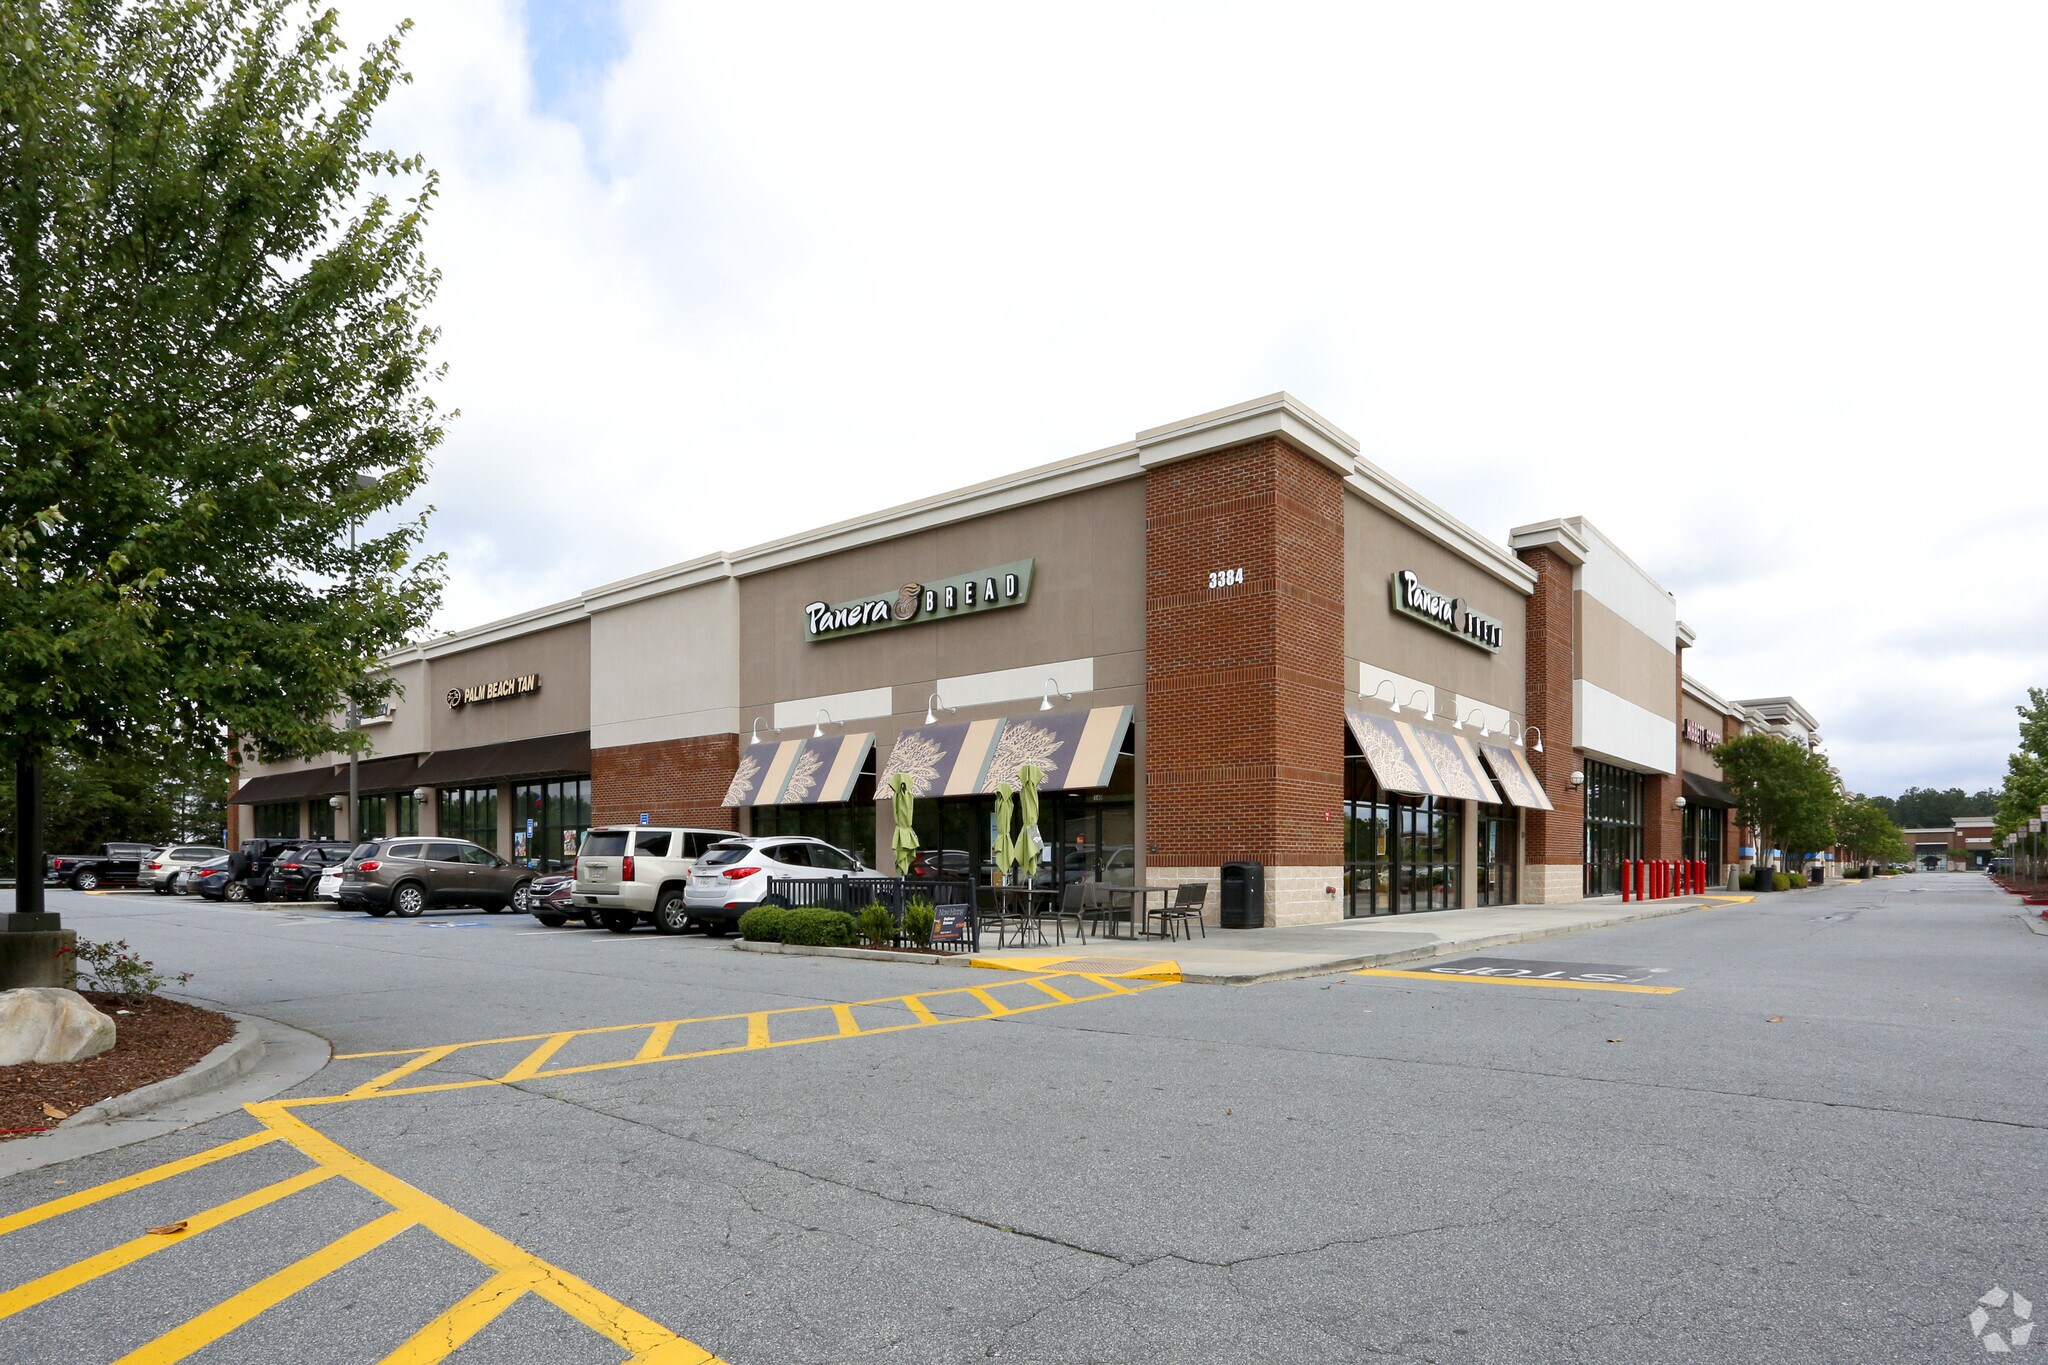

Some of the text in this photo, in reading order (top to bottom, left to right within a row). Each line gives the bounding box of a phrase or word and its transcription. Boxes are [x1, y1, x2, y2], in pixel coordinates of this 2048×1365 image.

[1209, 567, 1244, 589] 3384
[805, 573, 1018, 635] Panera BREAD
[1402, 569, 1454, 625] Panera
[464, 674, 536, 703] PALM BEACH TAN
[1429, 966, 1629, 983] STOP
